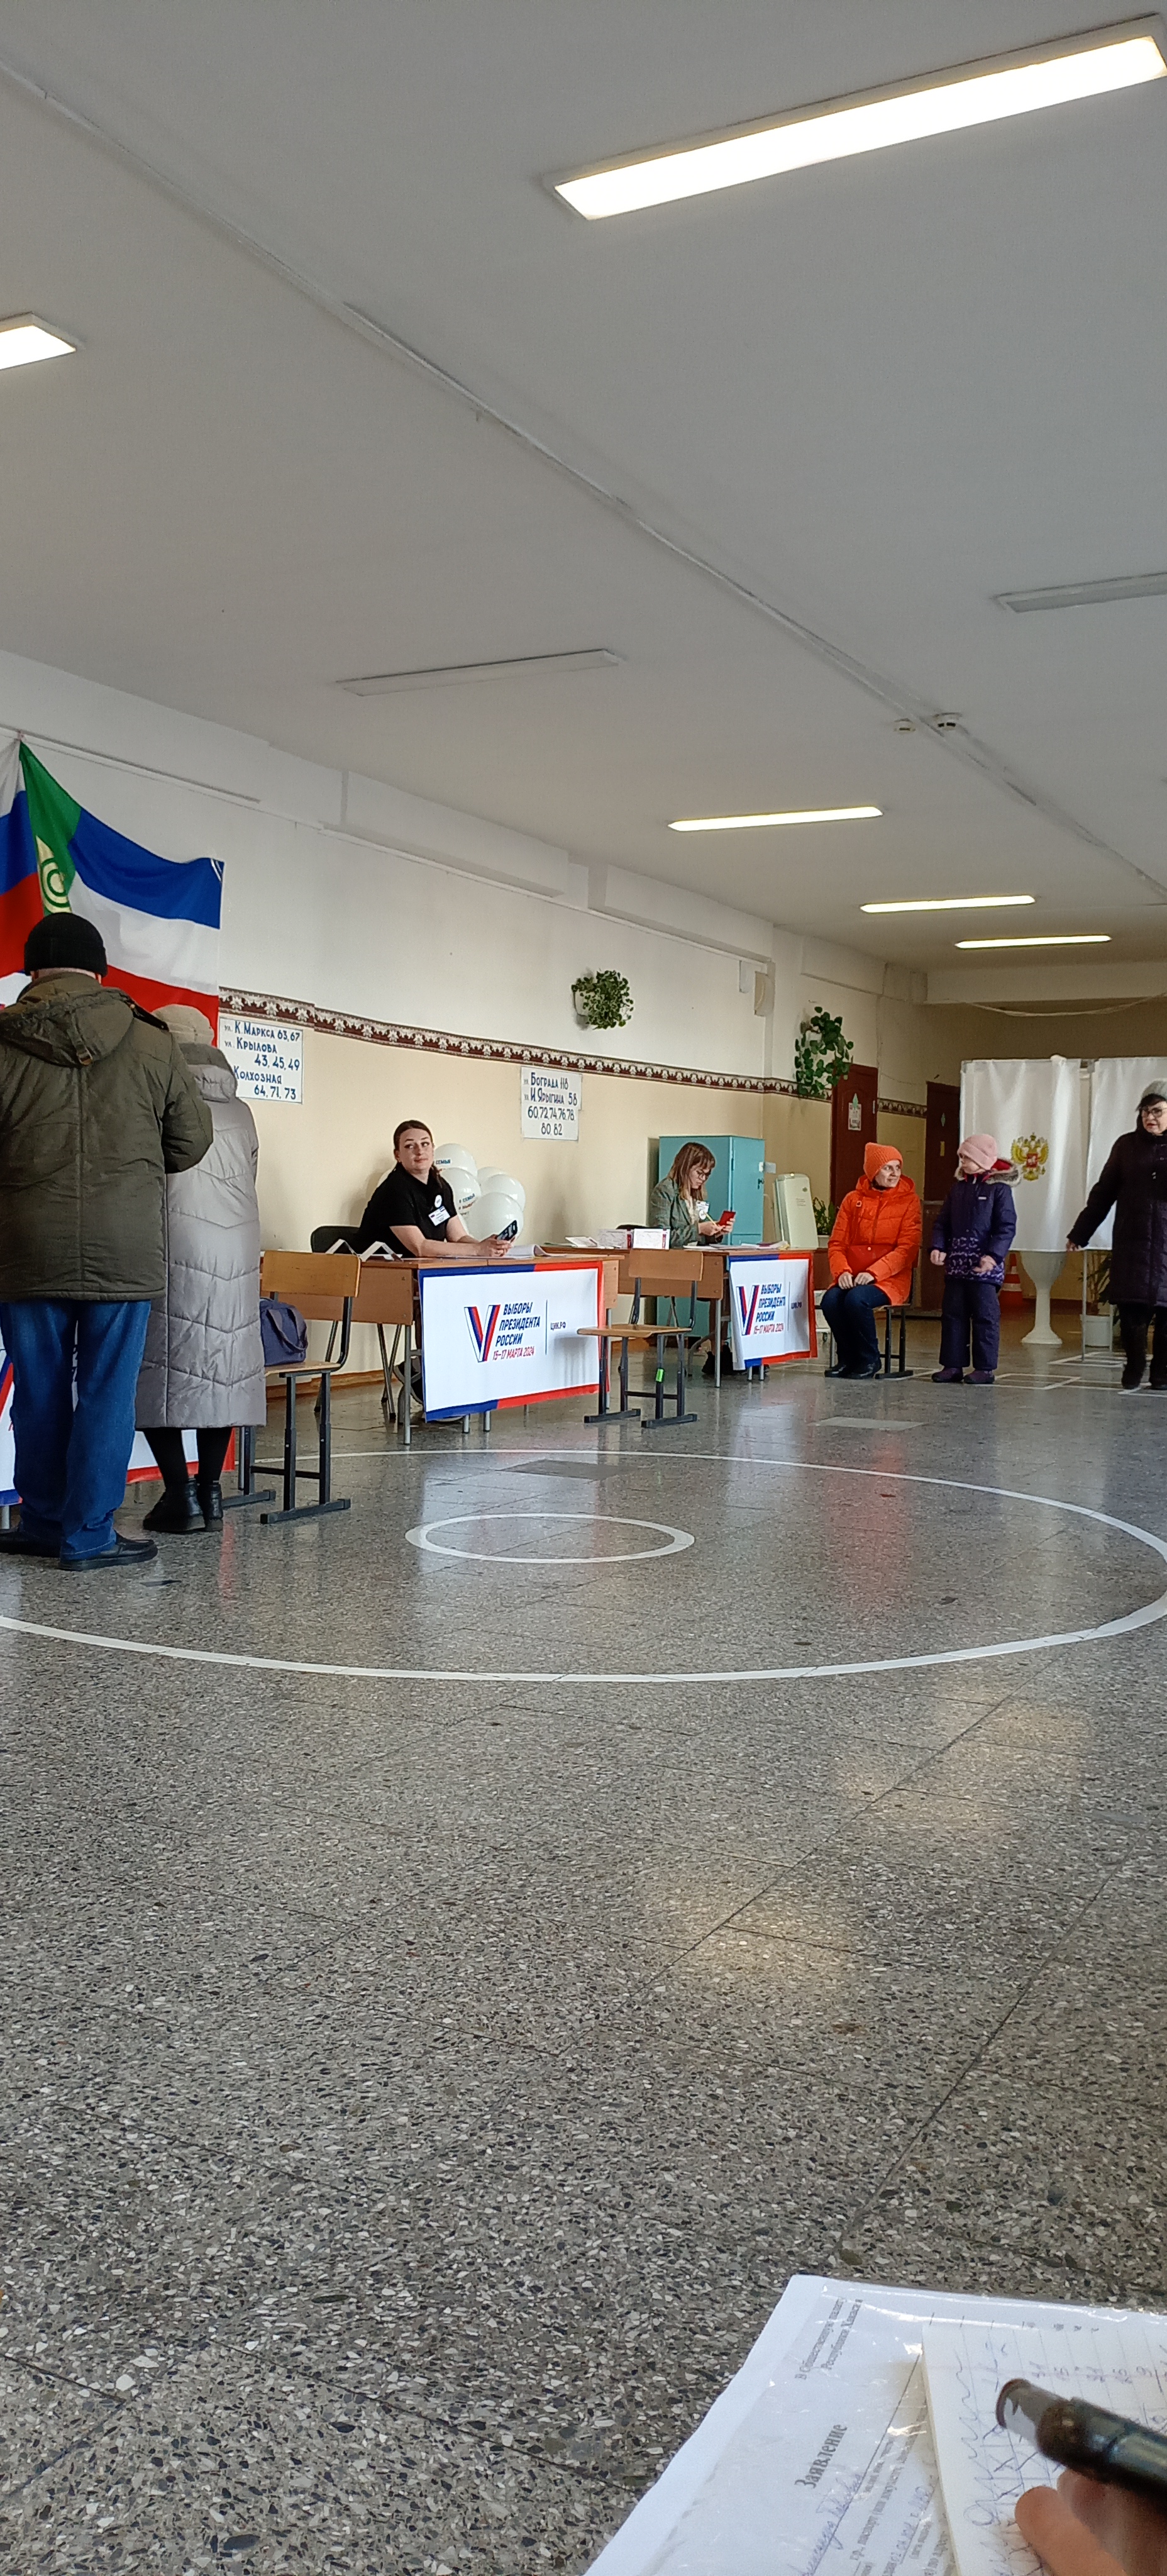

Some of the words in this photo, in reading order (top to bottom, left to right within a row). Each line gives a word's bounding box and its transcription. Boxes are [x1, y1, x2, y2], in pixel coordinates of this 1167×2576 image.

[288, 1058, 300, 1071] 49
[531, 1072, 558, 1089] БОГРАДА
[284, 1087, 296, 1100] 73
[568, 1092, 578, 1106] 58
[553, 1123, 563, 1136] 82
[760, 1283, 782, 1295] ВЫБОРЫ
[503, 1302, 533, 1316] ВЫБОРЫ
[499, 1316, 541, 1331] ПРЕЗИДЕНТА
[755, 1311, 775, 1323] РОССИИ
[495, 1333, 523, 1347] РОССИИ
[507, 1347, 523, 1359] МАРТА
[523, 1346, 535, 1357] 2024
[794, 2423, 848, 2489] Заявление
